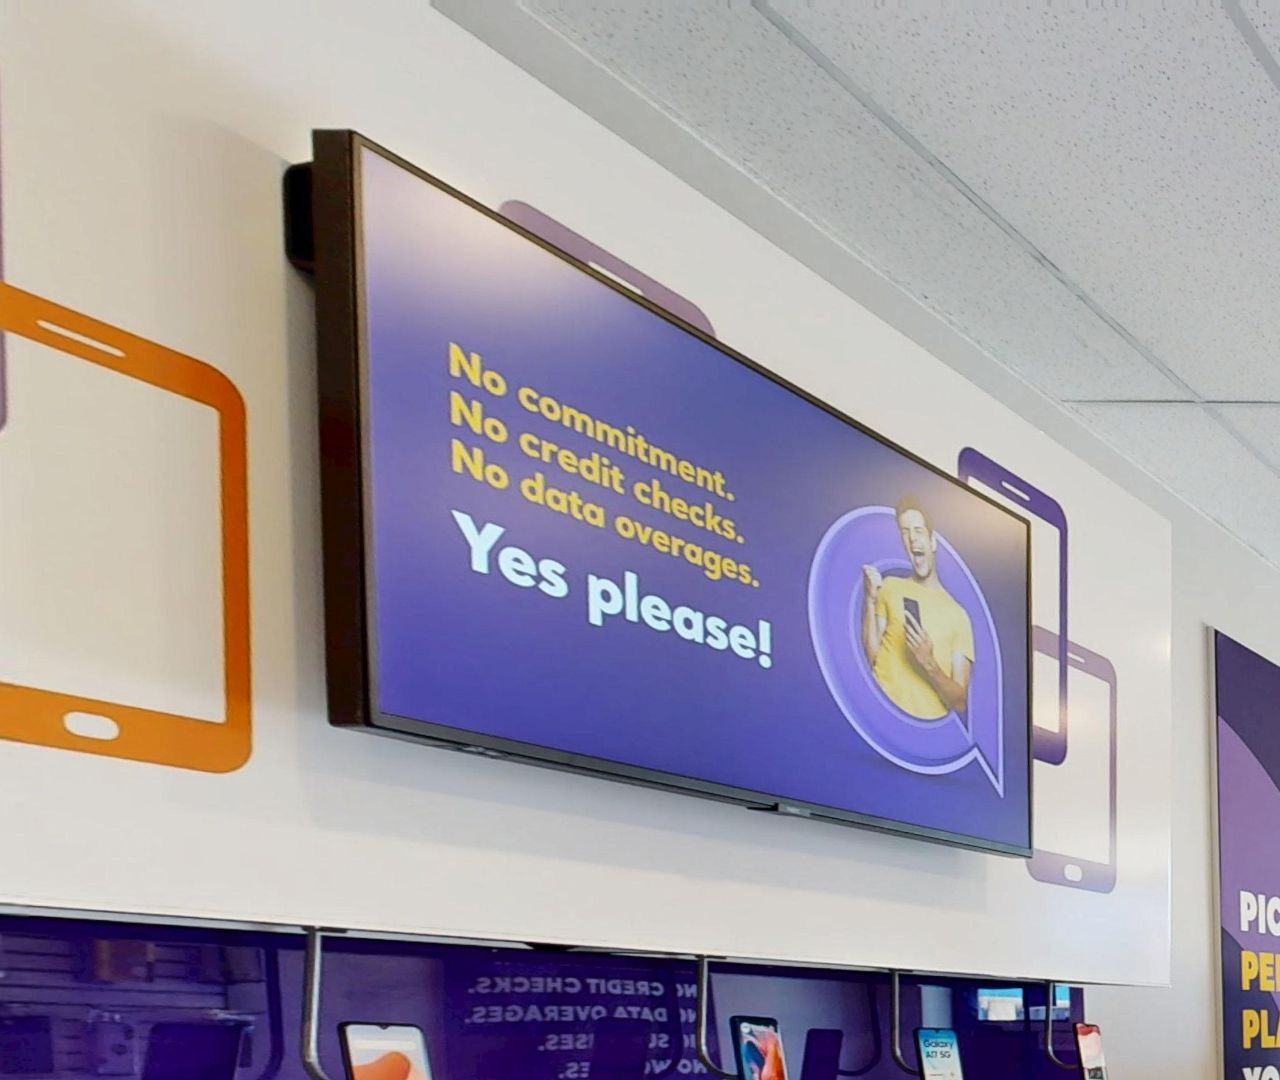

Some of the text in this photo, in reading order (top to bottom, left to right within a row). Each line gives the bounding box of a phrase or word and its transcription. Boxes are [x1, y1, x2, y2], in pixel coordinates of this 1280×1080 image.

[449, 342, 735, 502] No commitment.
[449, 391, 745, 545] No credit checks.
[451, 438, 760, 589] No data overages.
[452, 508, 772, 668] Yes please!
[923, 1039, 953, 1050] Galaxy
